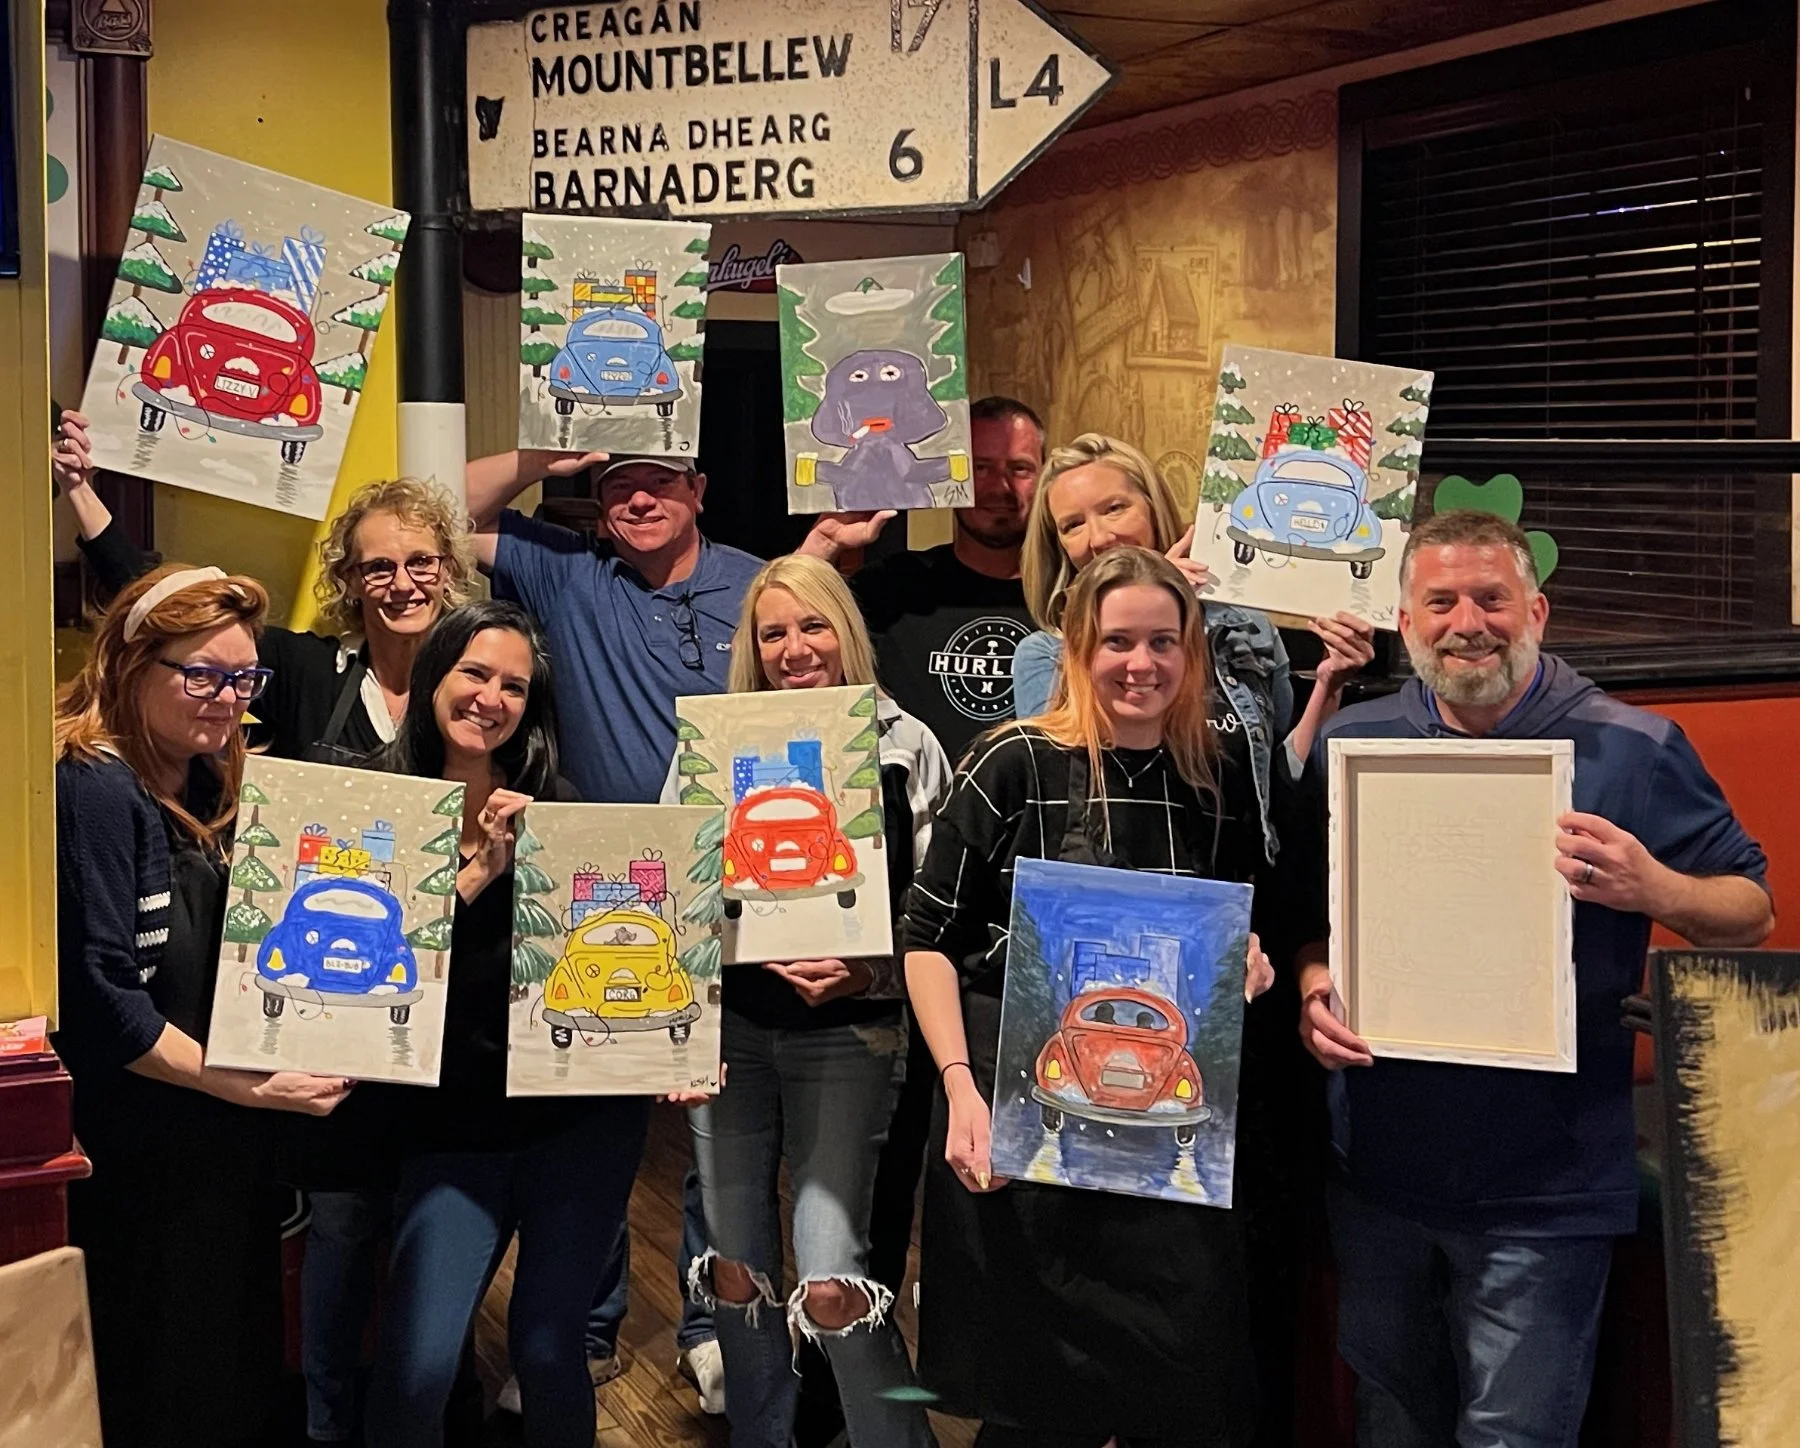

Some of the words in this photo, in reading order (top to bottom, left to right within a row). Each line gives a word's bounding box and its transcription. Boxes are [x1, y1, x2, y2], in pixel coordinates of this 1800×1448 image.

[532, 33, 854, 98] MOUNTBELLEW
[990, 54, 1064, 109] L4
[533, 121, 670, 158] BEARNA
[688, 112, 831, 150] DHEARG
[889, 127, 923, 182] 6
[534, 157, 815, 209] BARNADERG
